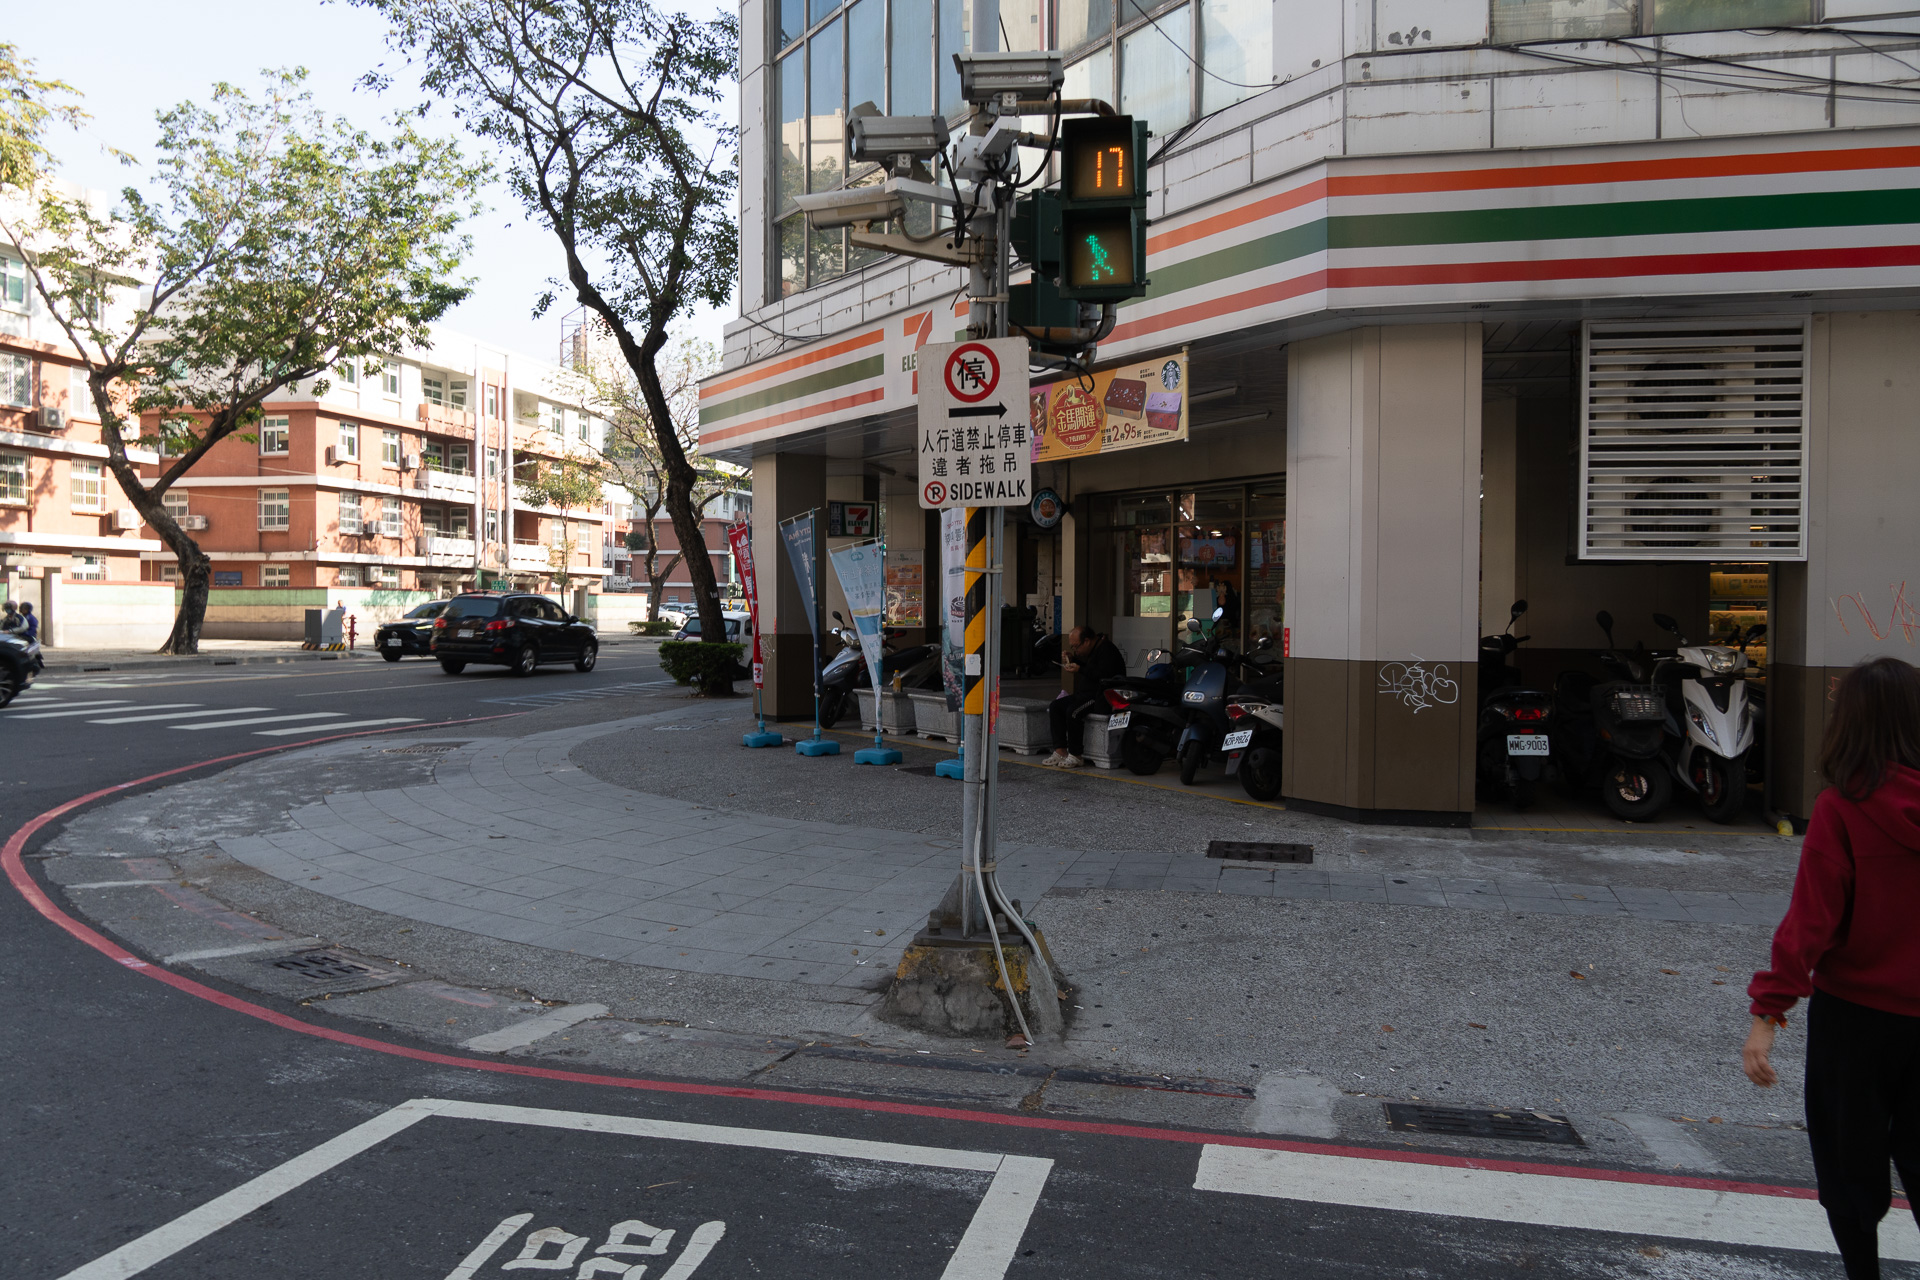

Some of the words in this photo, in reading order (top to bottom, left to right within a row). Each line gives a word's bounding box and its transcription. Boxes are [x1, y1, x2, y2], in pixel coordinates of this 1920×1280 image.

[1096, 147, 1124, 188] 17
[902, 353, 918, 373] ELE
[904, 309, 933, 395] 7
[957, 358, 986, 390] 停
[1056, 404, 1097, 433] 金馬開運
[922, 423, 1027, 453] 人行道禁止停車
[932, 453, 1017, 477] 違者拖吊
[950, 480, 1026, 501] SIDEWALK
[848, 507, 868, 534] 7
[1509, 740, 1548, 751] MMG-9003
